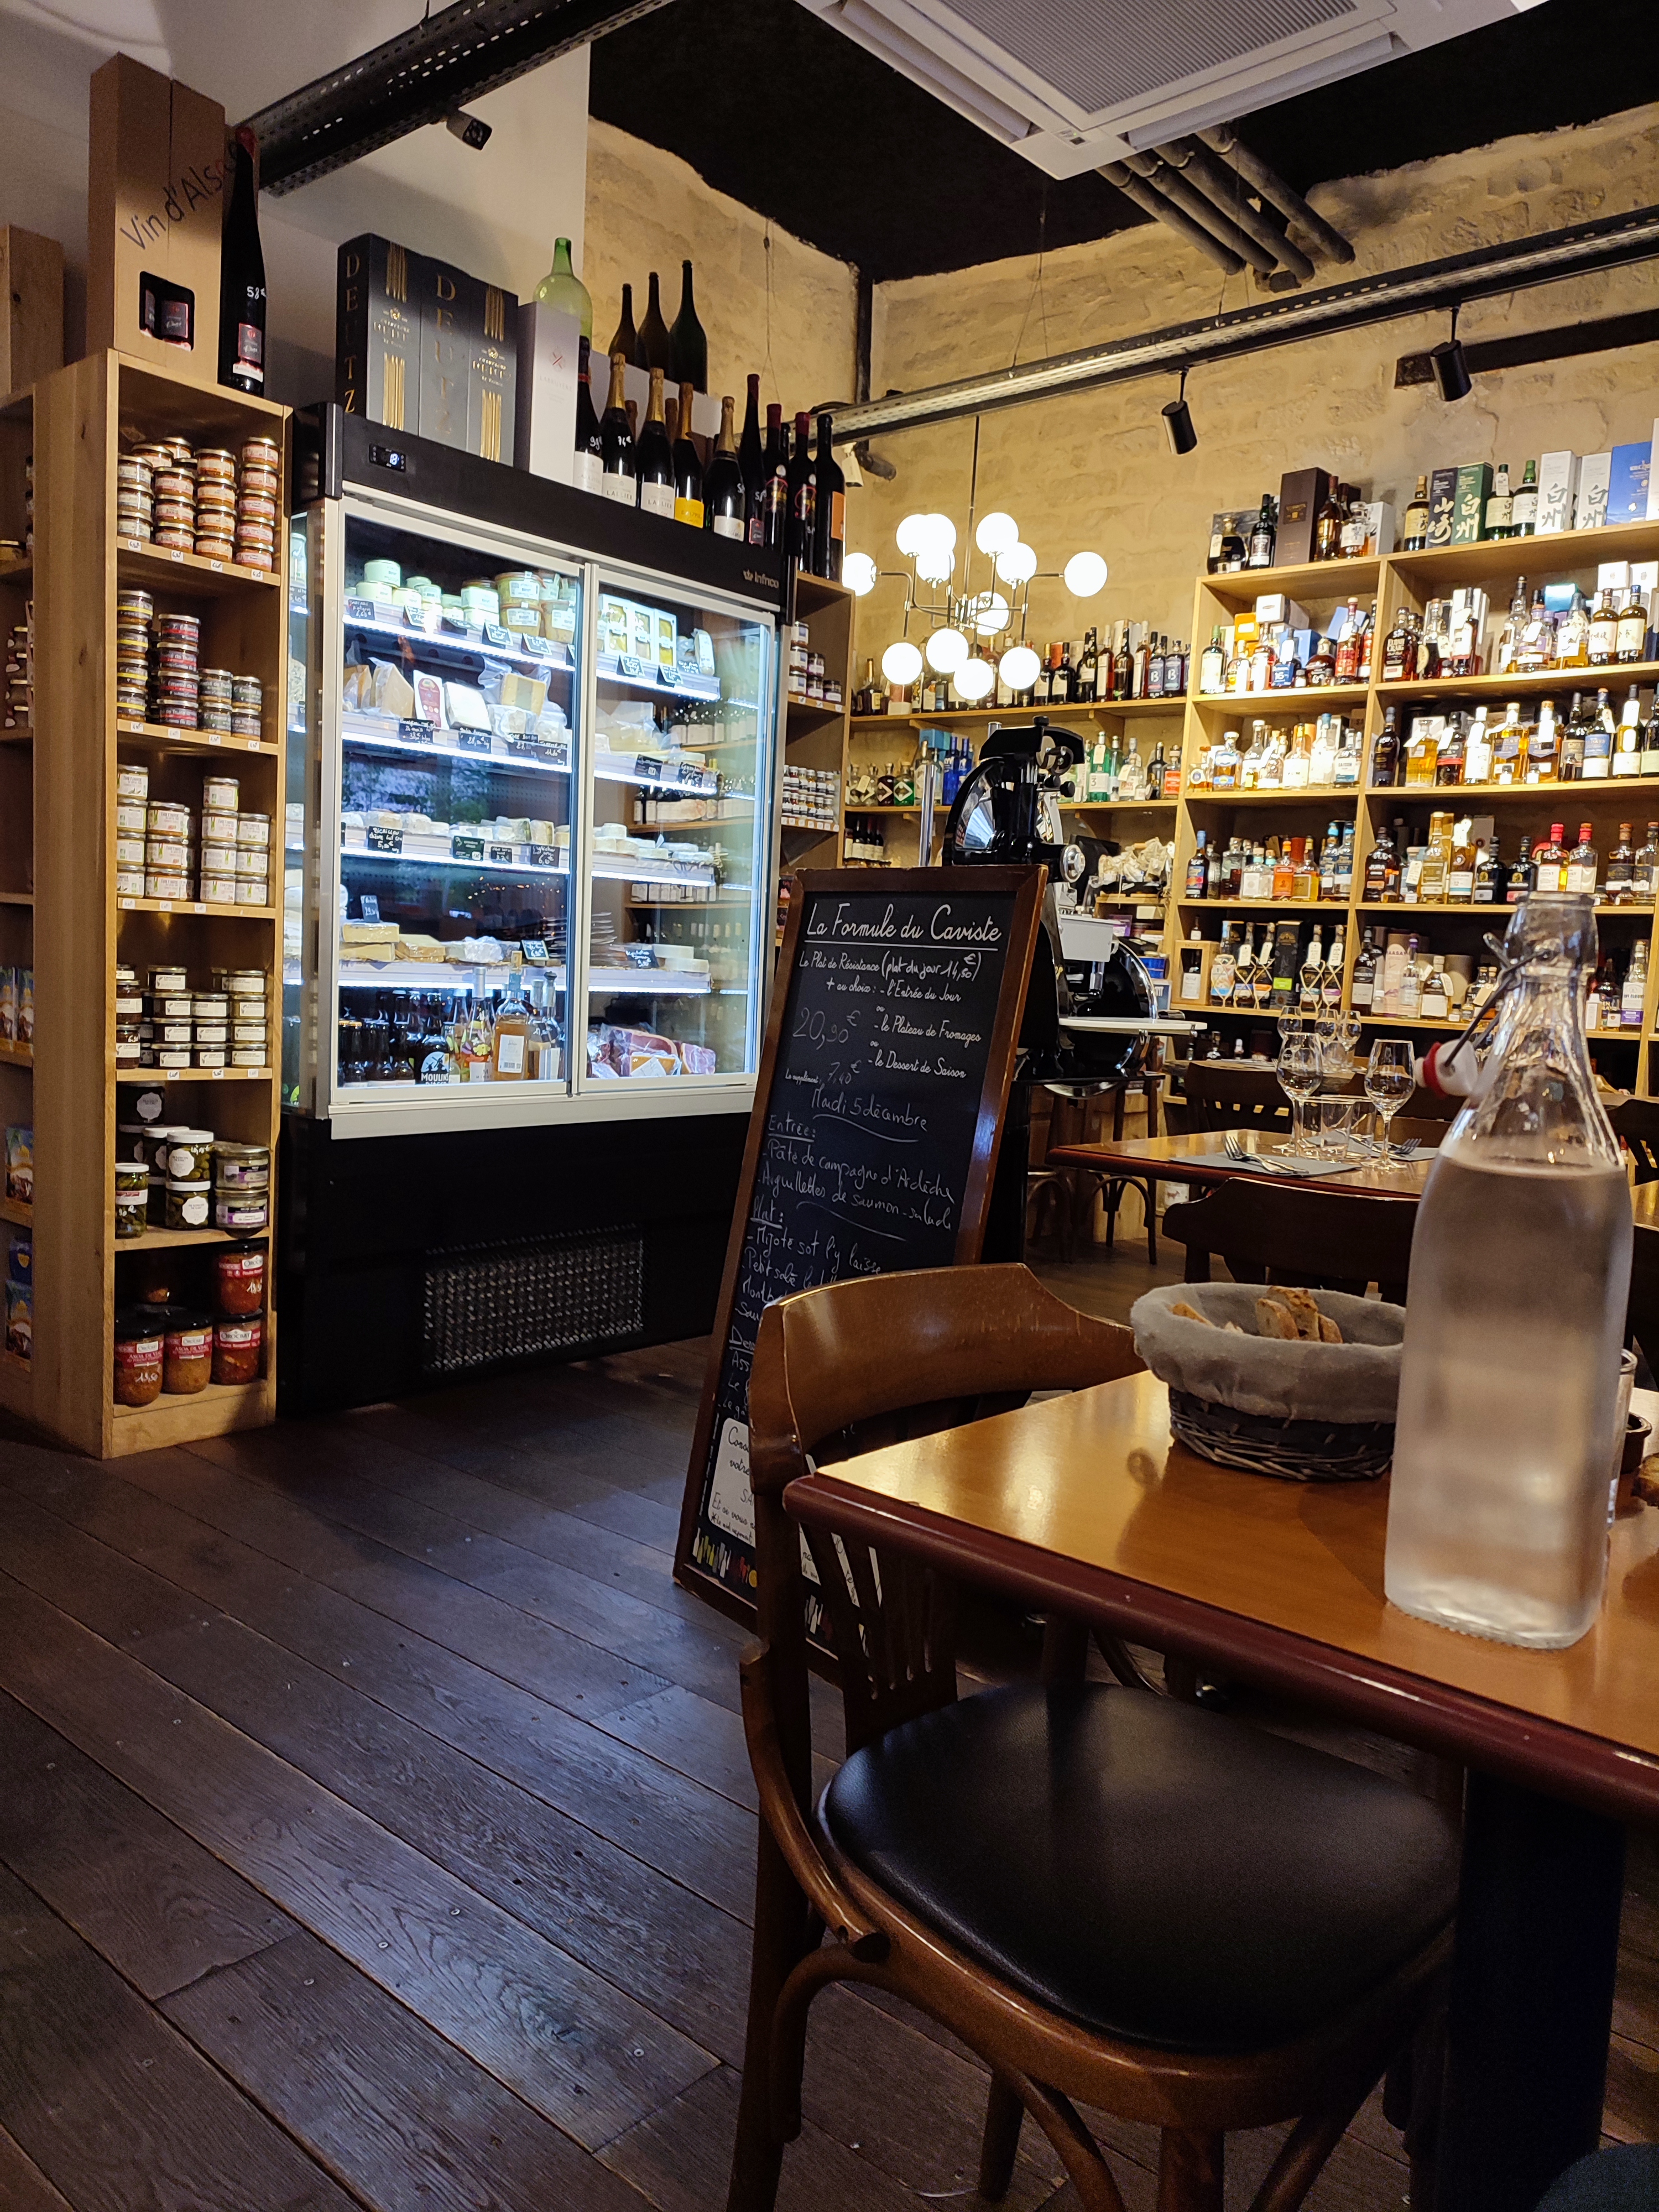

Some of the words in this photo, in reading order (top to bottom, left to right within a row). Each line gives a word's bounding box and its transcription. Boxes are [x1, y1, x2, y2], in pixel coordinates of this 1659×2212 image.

[119, 212, 166, 250] Vin
[1455, 493, 1481, 541] 白州
[1541, 483, 1568, 530] 白州
[1582, 484, 1609, 529] 白州
[754, 571, 780, 589] Infrico
[806, 902, 828, 936] La
[831, 902, 897, 938] Formule
[900, 914, 924, 939] du
[930, 904, 1002, 941] Caviste
[799, 951, 810, 968] Le
[811, 951, 828, 969] Plat
[827, 956, 837, 969] de
[838, 952, 880, 972] Résistance
[905, 959, 919, 974] du
[919, 963, 942, 980] jour
[836, 982, 848, 991] au
[886, 979, 924, 998] l'Entrée
[924, 987, 937, 1000] du
[938, 983, 962, 1002] Jour
[880, 1014, 890, 1032] le
[891, 1015, 924, 1036] Plateau
[925, 1024, 936, 1037] de
[938, 1020, 982, 1048] Fromages
[421, 1072, 449, 1082] MOULINS
[875, 1049, 884, 1067] le
[885, 1050, 919, 1072] Dessert
[920, 1061, 931, 1074] de
[933, 1057, 967, 1078] Saison
[811, 1083, 847, 1114] Mardi
[849, 1097, 862, 1115] 5
[863, 1093, 928, 1132] décembre
[768, 1139, 798, 1165] Pâté
[802, 1144, 815, 1166] de
[818, 1156, 878, 1191] campagne
[880, 1164, 956, 1204] d'Ardèche
[832, 1180, 847, 1203] de
[756, 1227, 793, 1258] Mijoté
[797, 1230, 820, 1256] sot
[826, 1235, 841, 1274] l'y
[744, 1246, 774, 1277] Petit
[774, 1262, 799, 1287] salé
[734, 1301, 760, 1321] Sau
[728, 1325, 755, 1350] Dess
[732, 1350, 750, 1372] Ass
[712, 1491, 722, 1511] Et
